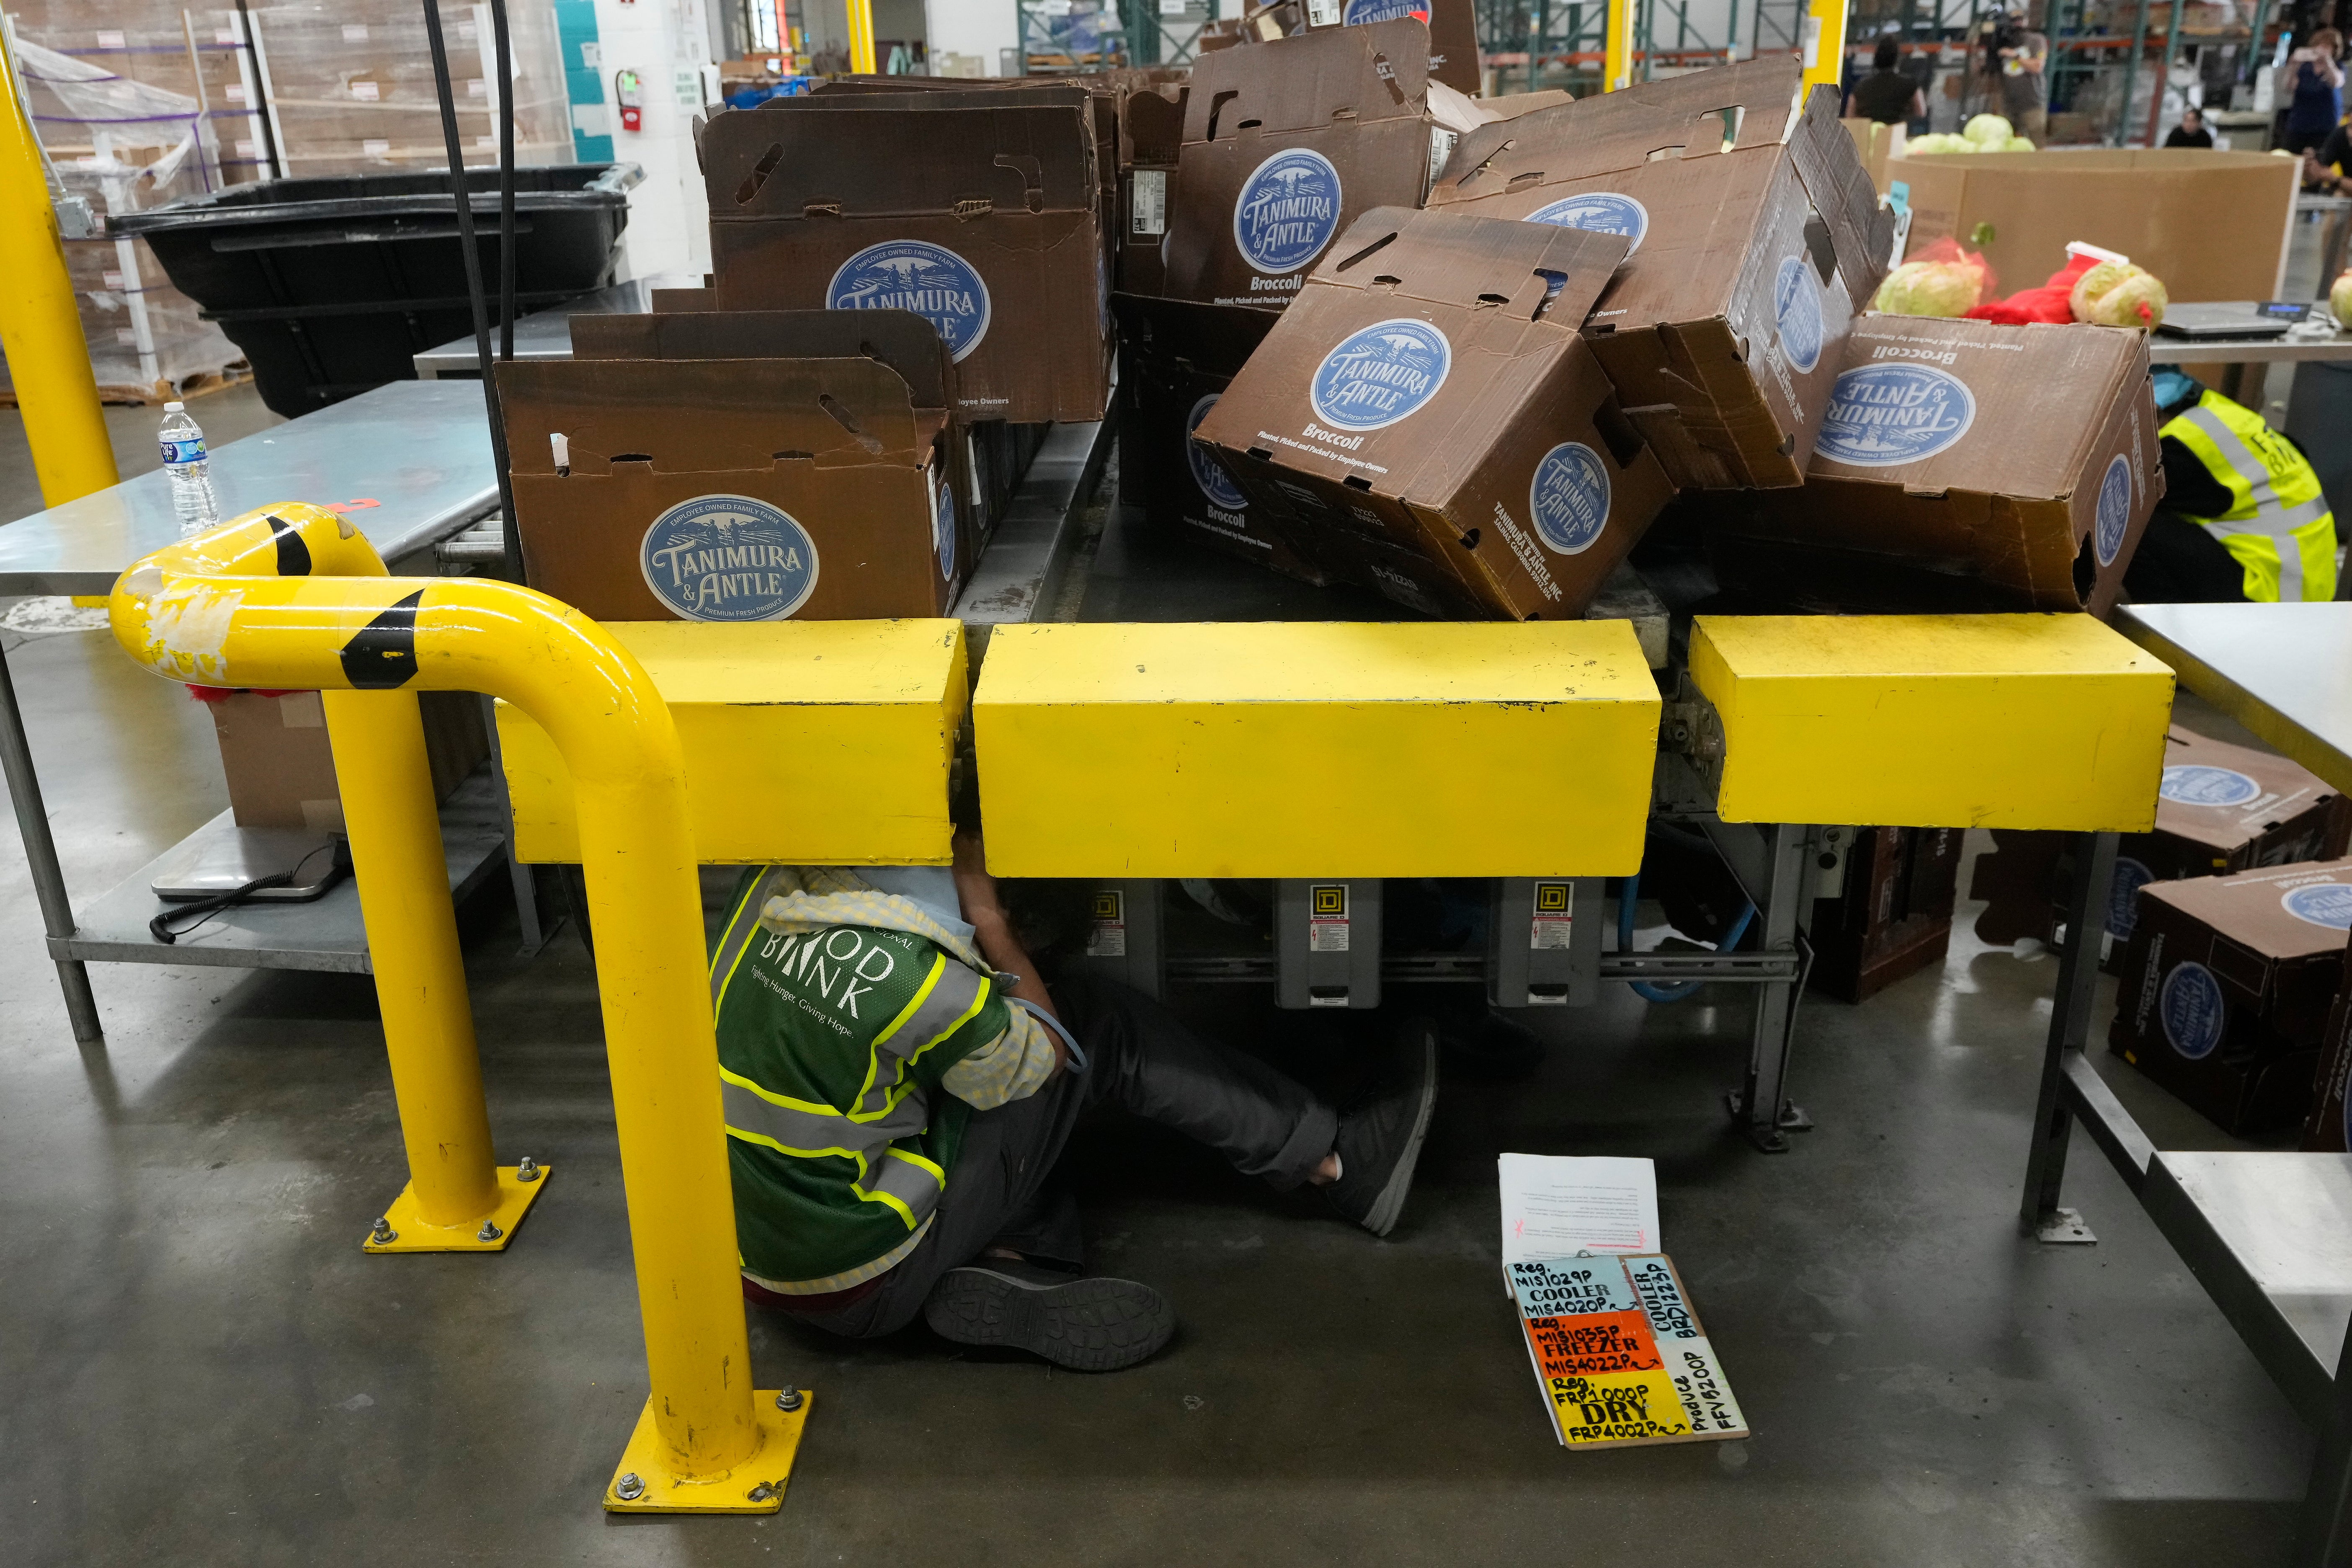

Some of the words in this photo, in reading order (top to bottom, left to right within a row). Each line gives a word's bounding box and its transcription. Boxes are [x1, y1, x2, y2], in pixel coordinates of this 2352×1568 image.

[1261, 164, 1283, 181] EMPLOYEE
[1300, 160, 1316, 168] FAMILY
[1315, 165, 1326, 176] FARM
[1243, 192, 1331, 236] TANIMURA
[1534, 206, 1564, 222] MPLOYEE
[1565, 201, 1589, 209] OWNED
[1610, 201, 1625, 211] FARM
[1254, 222, 1315, 258] ANTLE
[1254, 234, 1262, 248] &
[855, 251, 887, 271] EMPLOYEE
[914, 249, 938, 260] FAMILY
[938, 255, 956, 269] FARM
[1251, 274, 1302, 290] Broccoli
[837, 283, 977, 316] TANIMURA
[1282, 296, 1289, 304] by
[1597, 309, 1628, 317] Owners
[1367, 328, 1398, 338] EMPLOYEE
[1416, 331, 1432, 344] FAMILY
[1429, 342, 1439, 355] FARM
[1857, 331, 1896, 340] Employee
[1908, 335, 1938, 345] Packed
[1958, 340, 1987, 348] Picked
[1871, 345, 1957, 365] Broccoli
[1988, 342, 2024, 351] Planted,
[1330, 351, 1431, 396] TANIMURA
[1320, 380, 1404, 411] ANTLE
[1326, 384, 1339, 398] &
[1843, 380, 1949, 407] ANTLE
[1933, 389, 1947, 402] &
[1329, 405, 1347, 418] PREMIUM
[1825, 399, 1958, 435] TANIMUR
[1302, 423, 1364, 451] Broccoli
[162, 449, 173, 457] Life
[1257, 431, 1279, 443] Planted,
[1279, 437, 1299, 448] Picked
[1298, 443, 1310, 451] and
[1309, 445, 1330, 457] Packed
[1329, 452, 1338, 461] by
[1337, 454, 1366, 468] Employee
[1365, 462, 1389, 474] Owners
[1828, 444, 1852, 455] FAMILY
[1880, 446, 1919, 458] EMPLOYEE
[1540, 488, 1549, 501] &
[1543, 459, 1596, 536] TANIMURA
[670, 506, 704, 526] EMPLOYEE
[733, 504, 759, 515] FAMILY
[759, 511, 779, 525] FARM
[1208, 504, 1245, 529] Broccoli
[1536, 493, 1580, 539] ANTLE
[1494, 501, 1526, 549] TANIMURA
[1524, 547, 1531, 557] &
[1529, 555, 1551, 585] ANTLE,
[1549, 581, 1563, 602] INC.
[1522, 530, 1540, 557] DISTRIBUTED
[652, 538, 804, 587] TANIMURA
[1494, 518, 1510, 544] SALINAS,
[1511, 541, 1532, 573] CALIFORNIA
[1531, 570, 1544, 591] 93912,
[1543, 586, 1552, 601] USA
[683, 584, 696, 601] &
[687, 573, 784, 612] ANTLE
[704, 607, 735, 617] PREMIUM
[756, 597, 784, 612] PRODUCE
[751, 965, 770, 988] Fighting
[769, 979, 796, 1003] Hunger.
[798, 999, 826, 1024] Giving
[827, 1016, 854, 1039] Hope.
[1514, 1263, 1550, 1275] Reg.
[1516, 1270, 1592, 1287] MIS1029P
[1529, 1284, 1611, 1302] COOLER
[1634, 1273, 1672, 1332] COOLER
[1646, 1263, 1698, 1338] BRD1223P
[1524, 1297, 1606, 1317] MIS4020P
[1530, 1318, 1566, 1331] Reg.
[1537, 1325, 1620, 1344] MIS1035P
[1544, 1338, 1639, 1357] FREEZER
[1545, 1353, 1631, 1375] MIS4022P
[1551, 1377, 1595, 1393] Reg.
[1554, 1384, 1649, 1407] FRP1000P
[1579, 1400, 1650, 1425] DRY
[1570, 1421, 1658, 1442] FRP4002P
